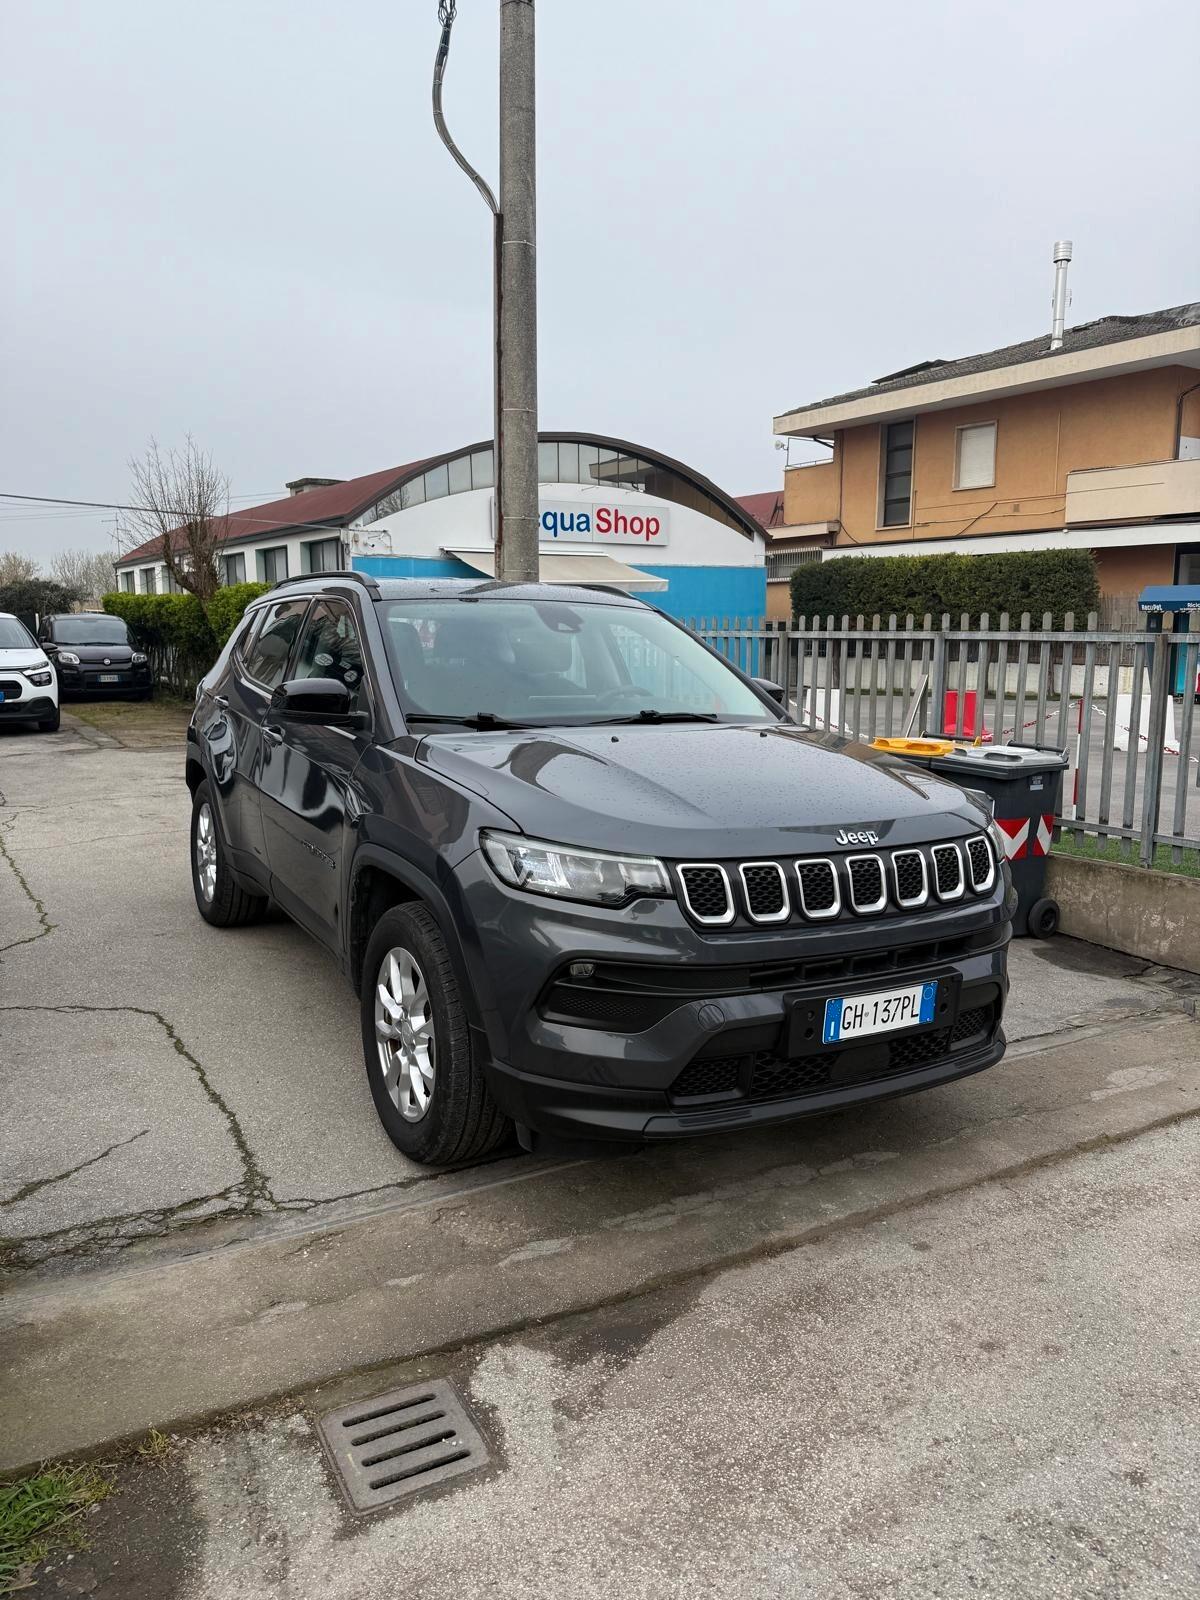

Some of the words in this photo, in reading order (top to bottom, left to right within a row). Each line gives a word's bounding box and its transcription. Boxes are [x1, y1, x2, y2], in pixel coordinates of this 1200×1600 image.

[595, 507, 660, 541] Shop
[835, 829, 879, 846] Jeep
[842, 1003, 864, 1030] GH
[873, 994, 919, 1026] 137PL
